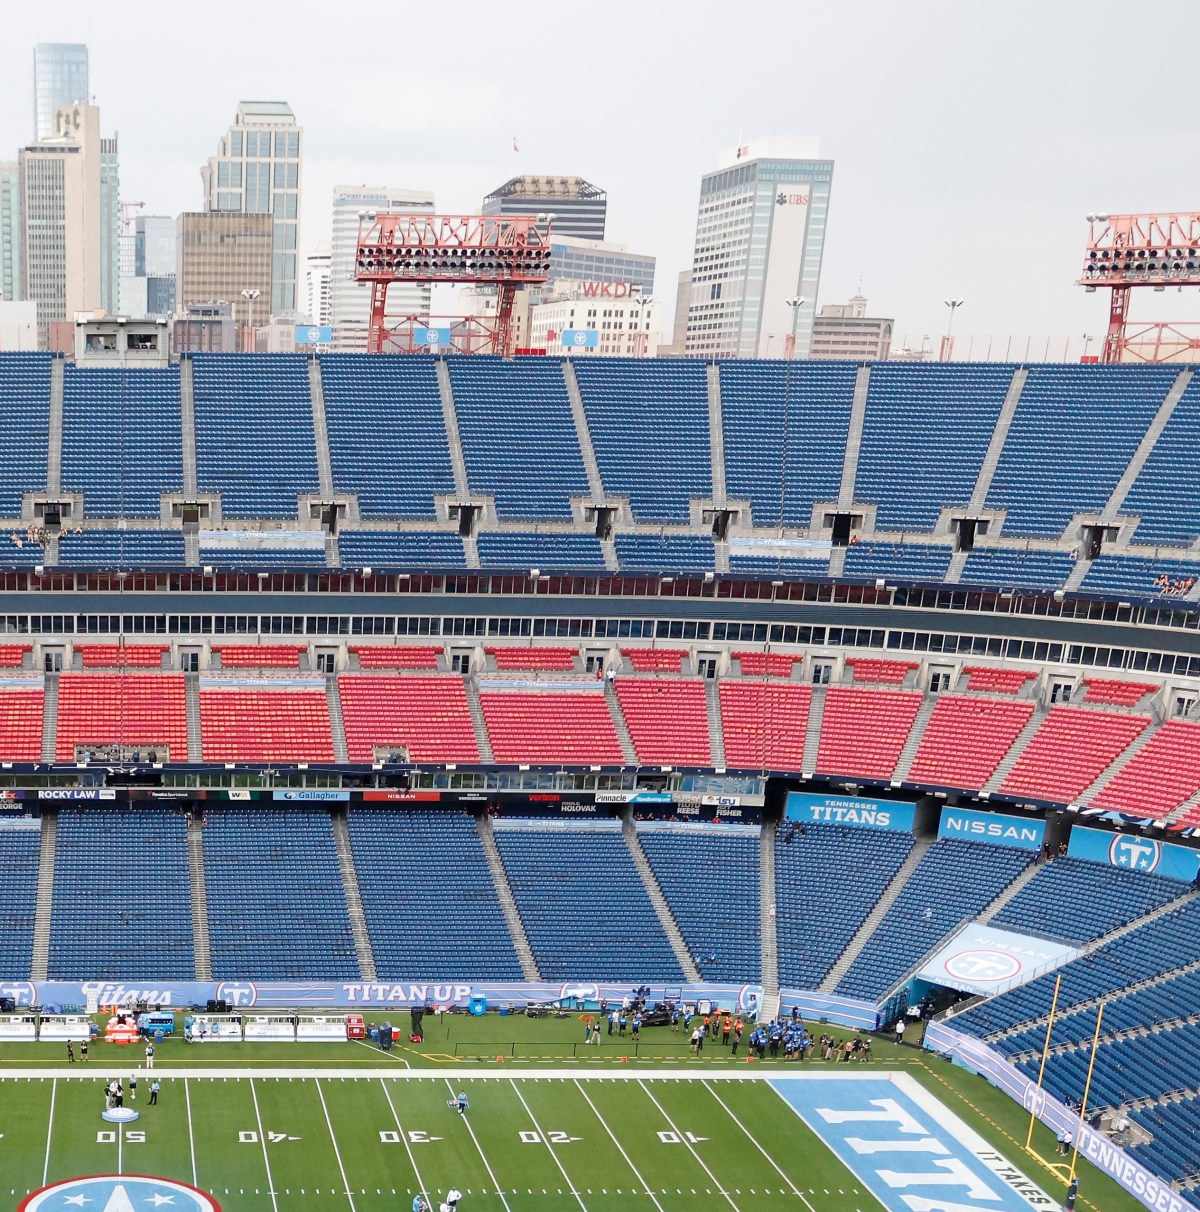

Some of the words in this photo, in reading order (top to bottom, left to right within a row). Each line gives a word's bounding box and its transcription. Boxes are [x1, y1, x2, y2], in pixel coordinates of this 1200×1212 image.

[789, 195, 809, 205] UBS
[583, 281, 643, 298] WKDF
[38, 790, 72, 799] ROCKY
[74, 790, 96, 799] LAW
[298, 791, 339, 800] Gallagher
[597, 794, 627, 802] Pinnacle
[677, 807, 700, 815] REESE
[824, 800, 877, 810] TENNESSEE
[810, 805, 890, 827] TITANS
[947, 818, 1037, 842] NISSAN
[975, 937, 1052, 960] NISSAN
[343, 984, 434, 1001] TITAN
[437, 985, 471, 1001] UP
[935, 976, 974, 993] NISSAN
[81, 981, 172, 1006] Titans
[976, 1150, 1004, 1163] IT
[996, 1167, 1052, 1205] TAKES
